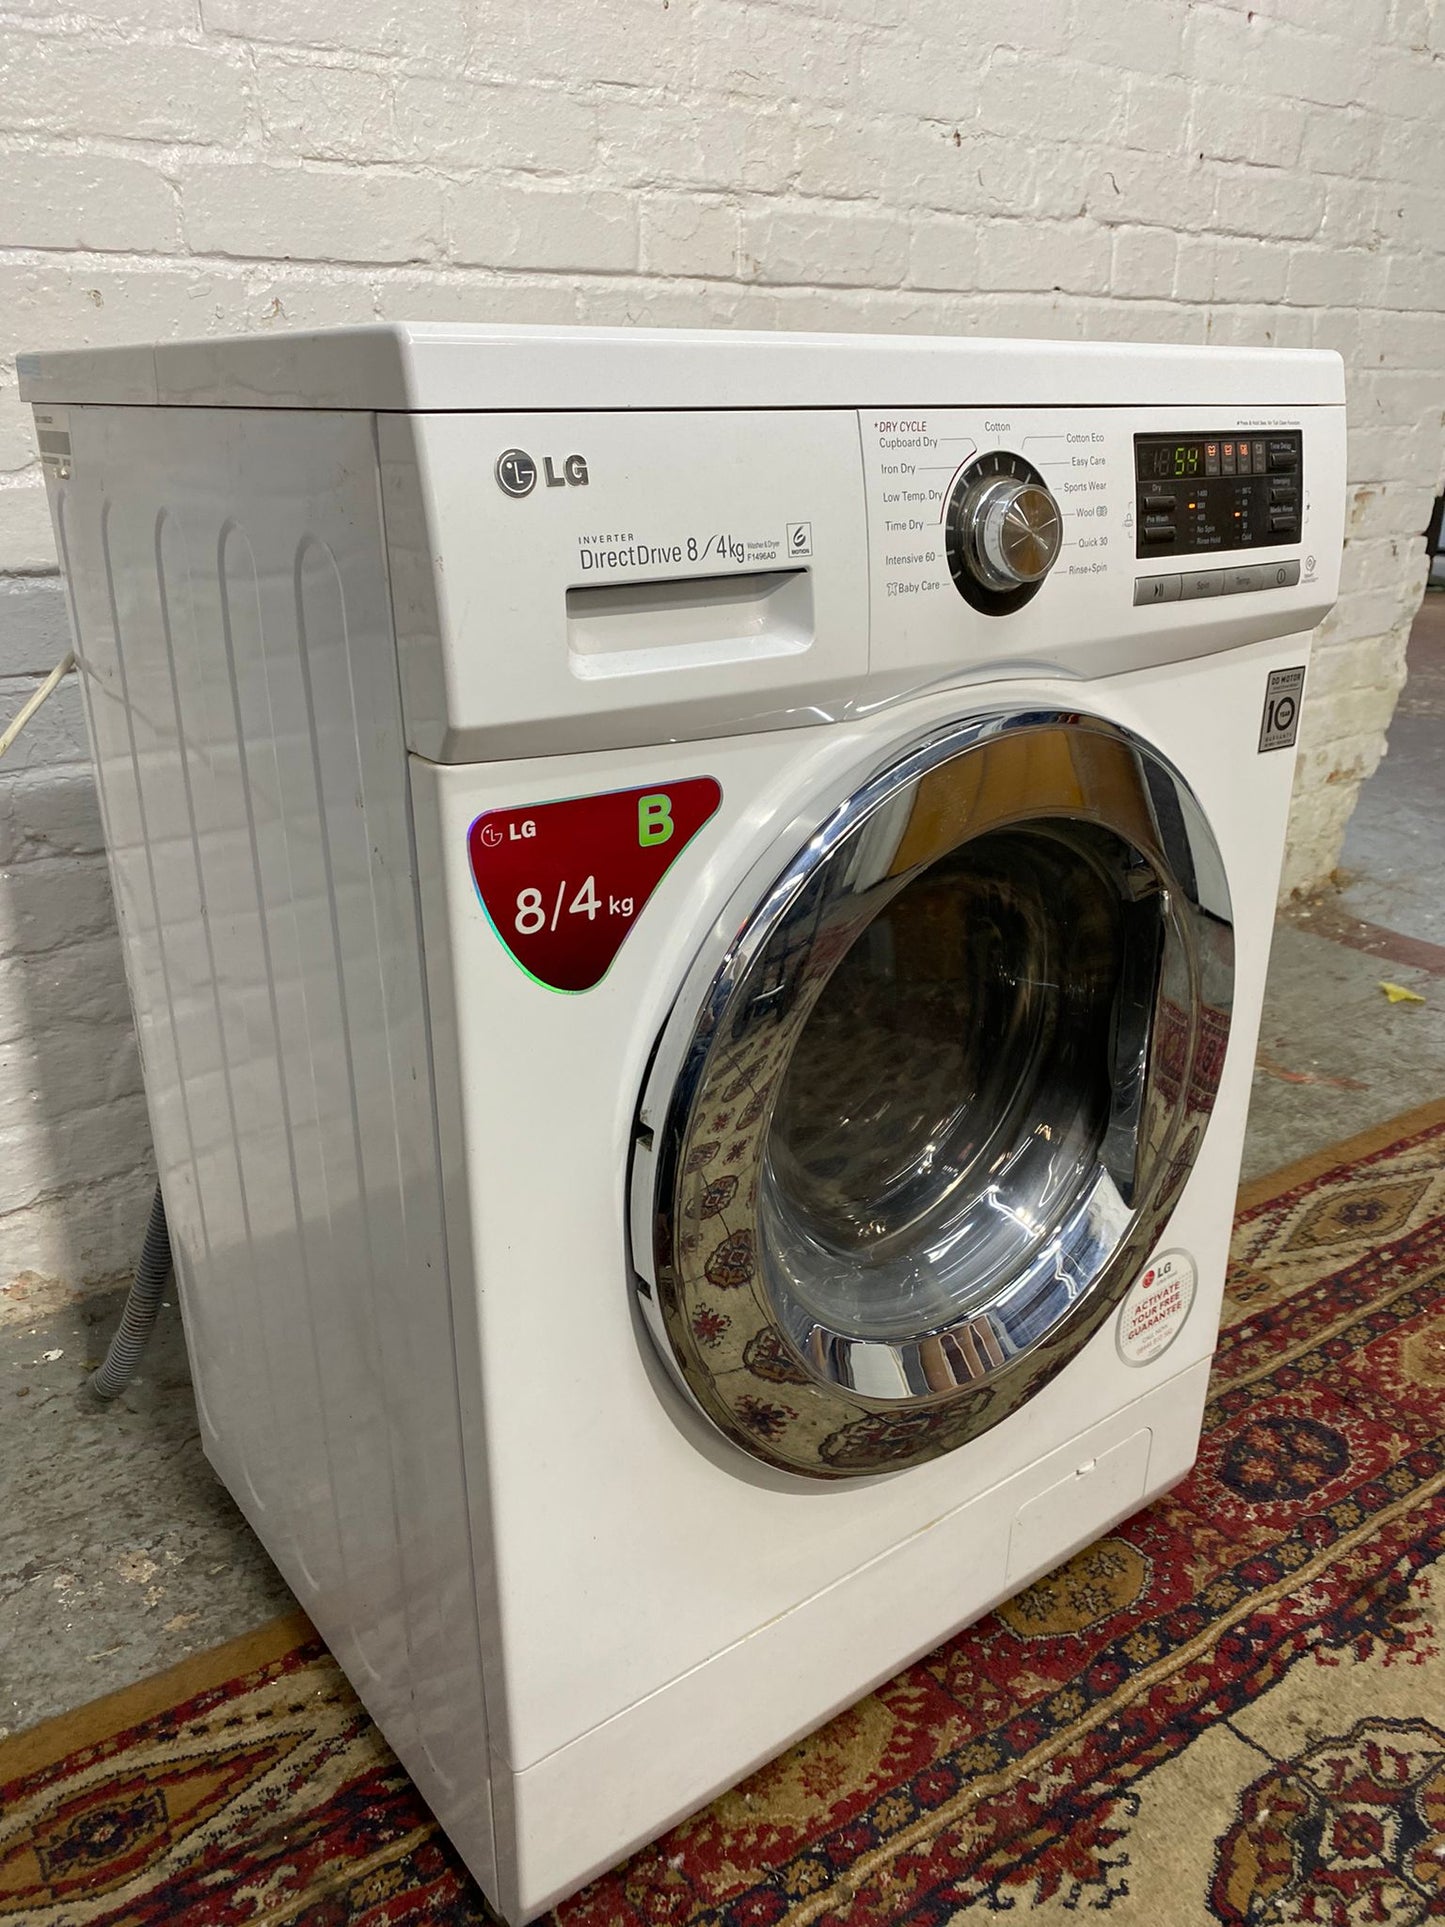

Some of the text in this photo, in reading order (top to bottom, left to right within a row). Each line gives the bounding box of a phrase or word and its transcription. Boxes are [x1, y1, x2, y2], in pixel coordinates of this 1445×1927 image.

[900, 421, 927, 432] CYCLE
[984, 421, 1011, 432] Cotton
[879, 437, 938, 450] Cupboard Dry
[1066, 433, 1104, 443] Cotton Eco
[1071, 456, 1106, 468] Easy Care
[1175, 447, 1198, 475] 54
[542, 454, 590, 487] LG
[881, 463, 916, 475] Iron Dry
[1064, 481, 1107, 494] Sports Wear
[883, 490, 943, 503] Low Temp. Dry
[1076, 507, 1095, 517] Wool
[885, 519, 924, 531] Time Dry
[578, 533, 634, 544] INVERTER
[1078, 536, 1108, 548] Quick 30
[886, 551, 936, 566] Intensive 60
[1069, 562, 1107, 575] Rinse+Spin
[898, 580, 940, 594] Baby Care
[1281, 674, 1301, 683] MOTOR
[1267, 697, 1295, 733] 10
[638, 793, 674, 847] B
[509, 820, 537, 840] LG
[609, 895, 634, 917] kg
[1157, 1262, 1171, 1278] LG
[1135, 1280, 1180, 1315] ACTIVATE
[1132, 1291, 1180, 1326] YOUR FREE
[1128, 1300, 1182, 1340] GUARANTEE
